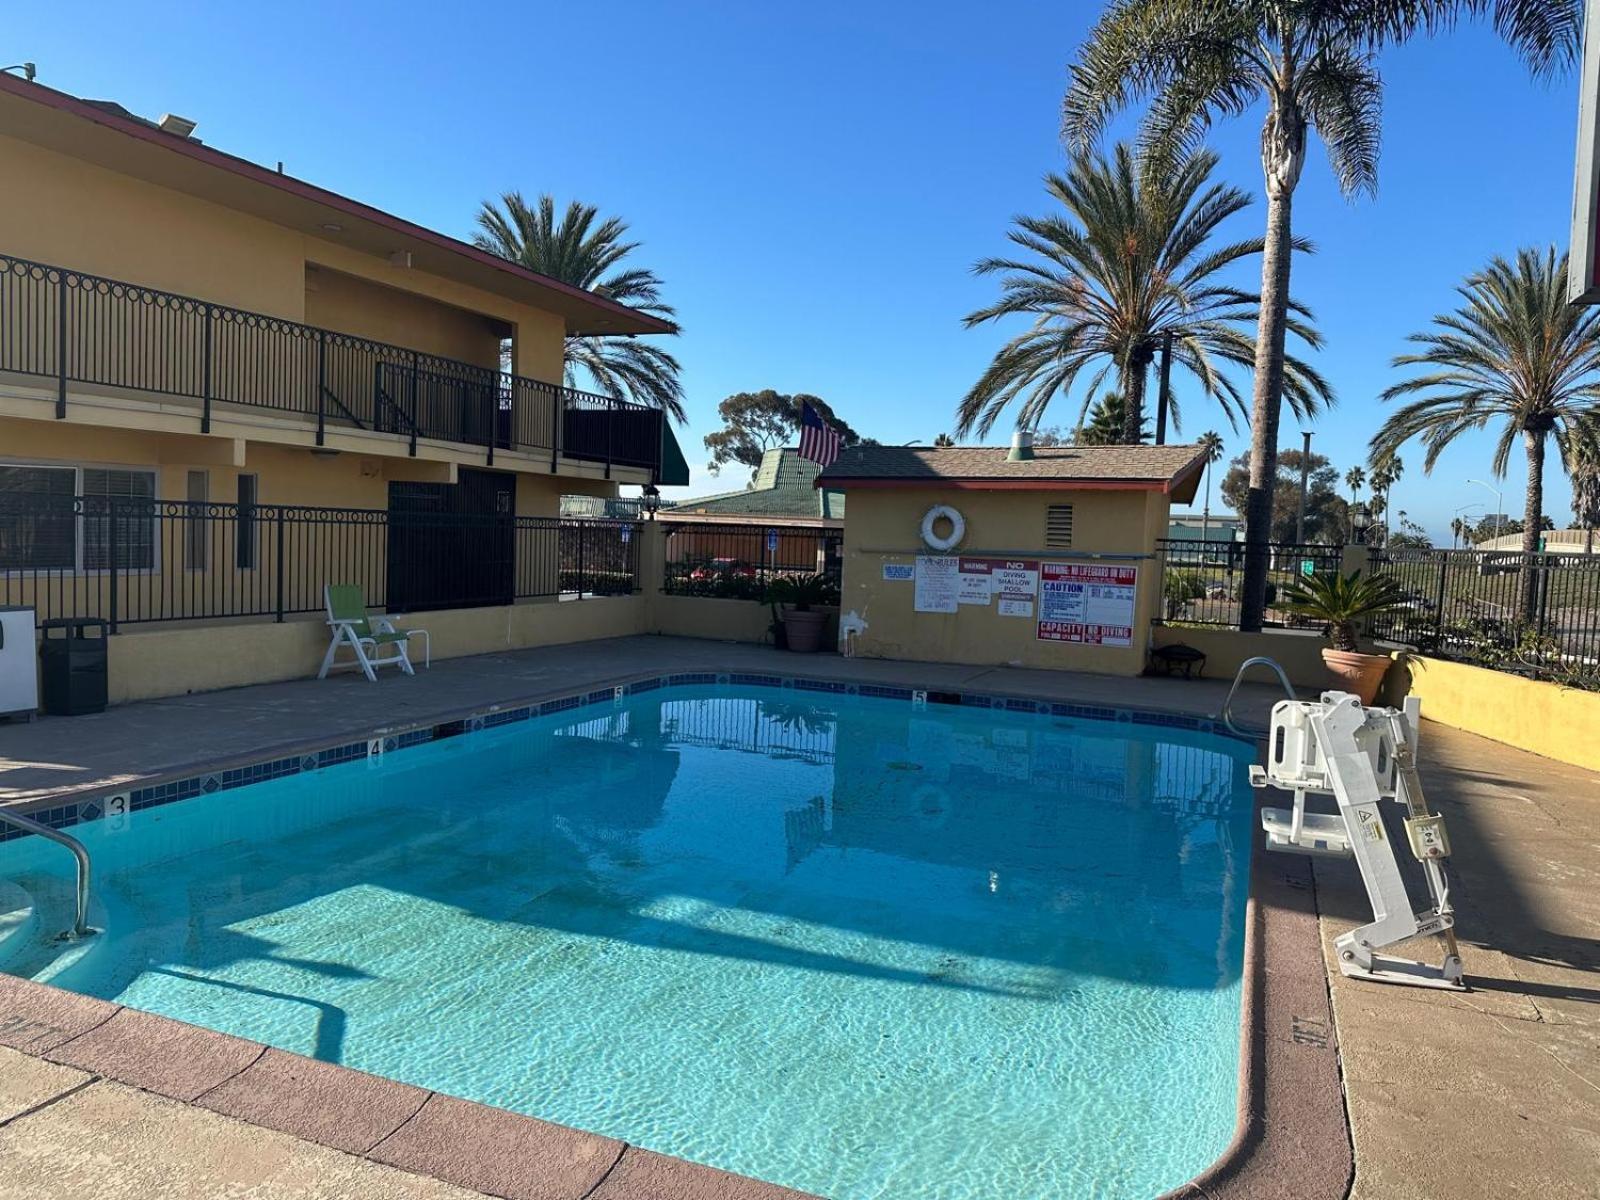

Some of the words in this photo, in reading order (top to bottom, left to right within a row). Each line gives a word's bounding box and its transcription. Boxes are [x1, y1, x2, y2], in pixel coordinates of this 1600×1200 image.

[1006, 561, 1024, 570] NO
[1003, 571, 1026, 579] DIVING
[1079, 566, 1109, 577] LIFEGUARD
[998, 578, 1031, 586] SHALLOW
[1043, 582, 1084, 593] CAUTION
[1040, 622, 1082, 633] CAPACITY
[1088, 625, 1099, 635] NO
[1101, 626, 1129, 637] DIVING
[371, 740, 380, 755] 4
[110, 796, 125, 816] 3
